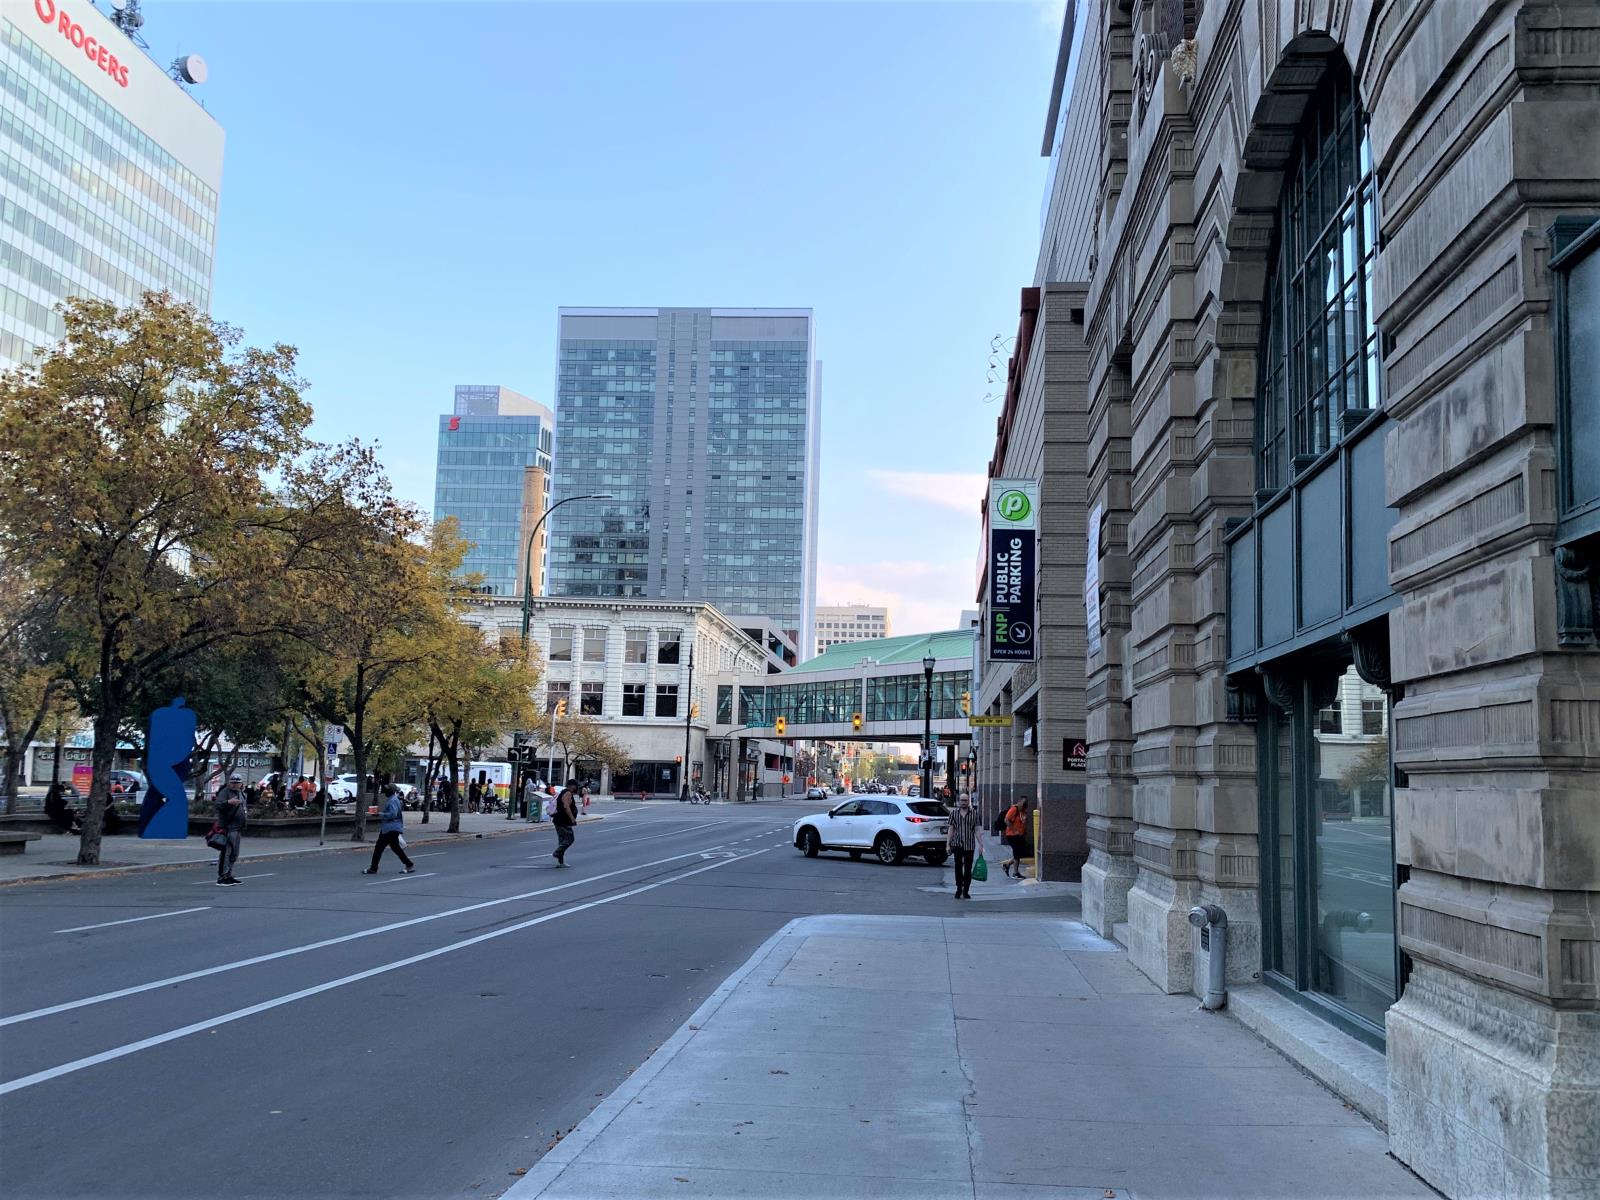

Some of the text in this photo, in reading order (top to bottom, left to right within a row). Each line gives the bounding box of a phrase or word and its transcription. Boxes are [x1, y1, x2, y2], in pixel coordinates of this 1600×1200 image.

[58, 11, 129, 88] ROGERS
[996, 552, 1009, 603] PUBLIC
[1009, 537, 1022, 604] PARKING
[995, 613, 1008, 643] FNP
